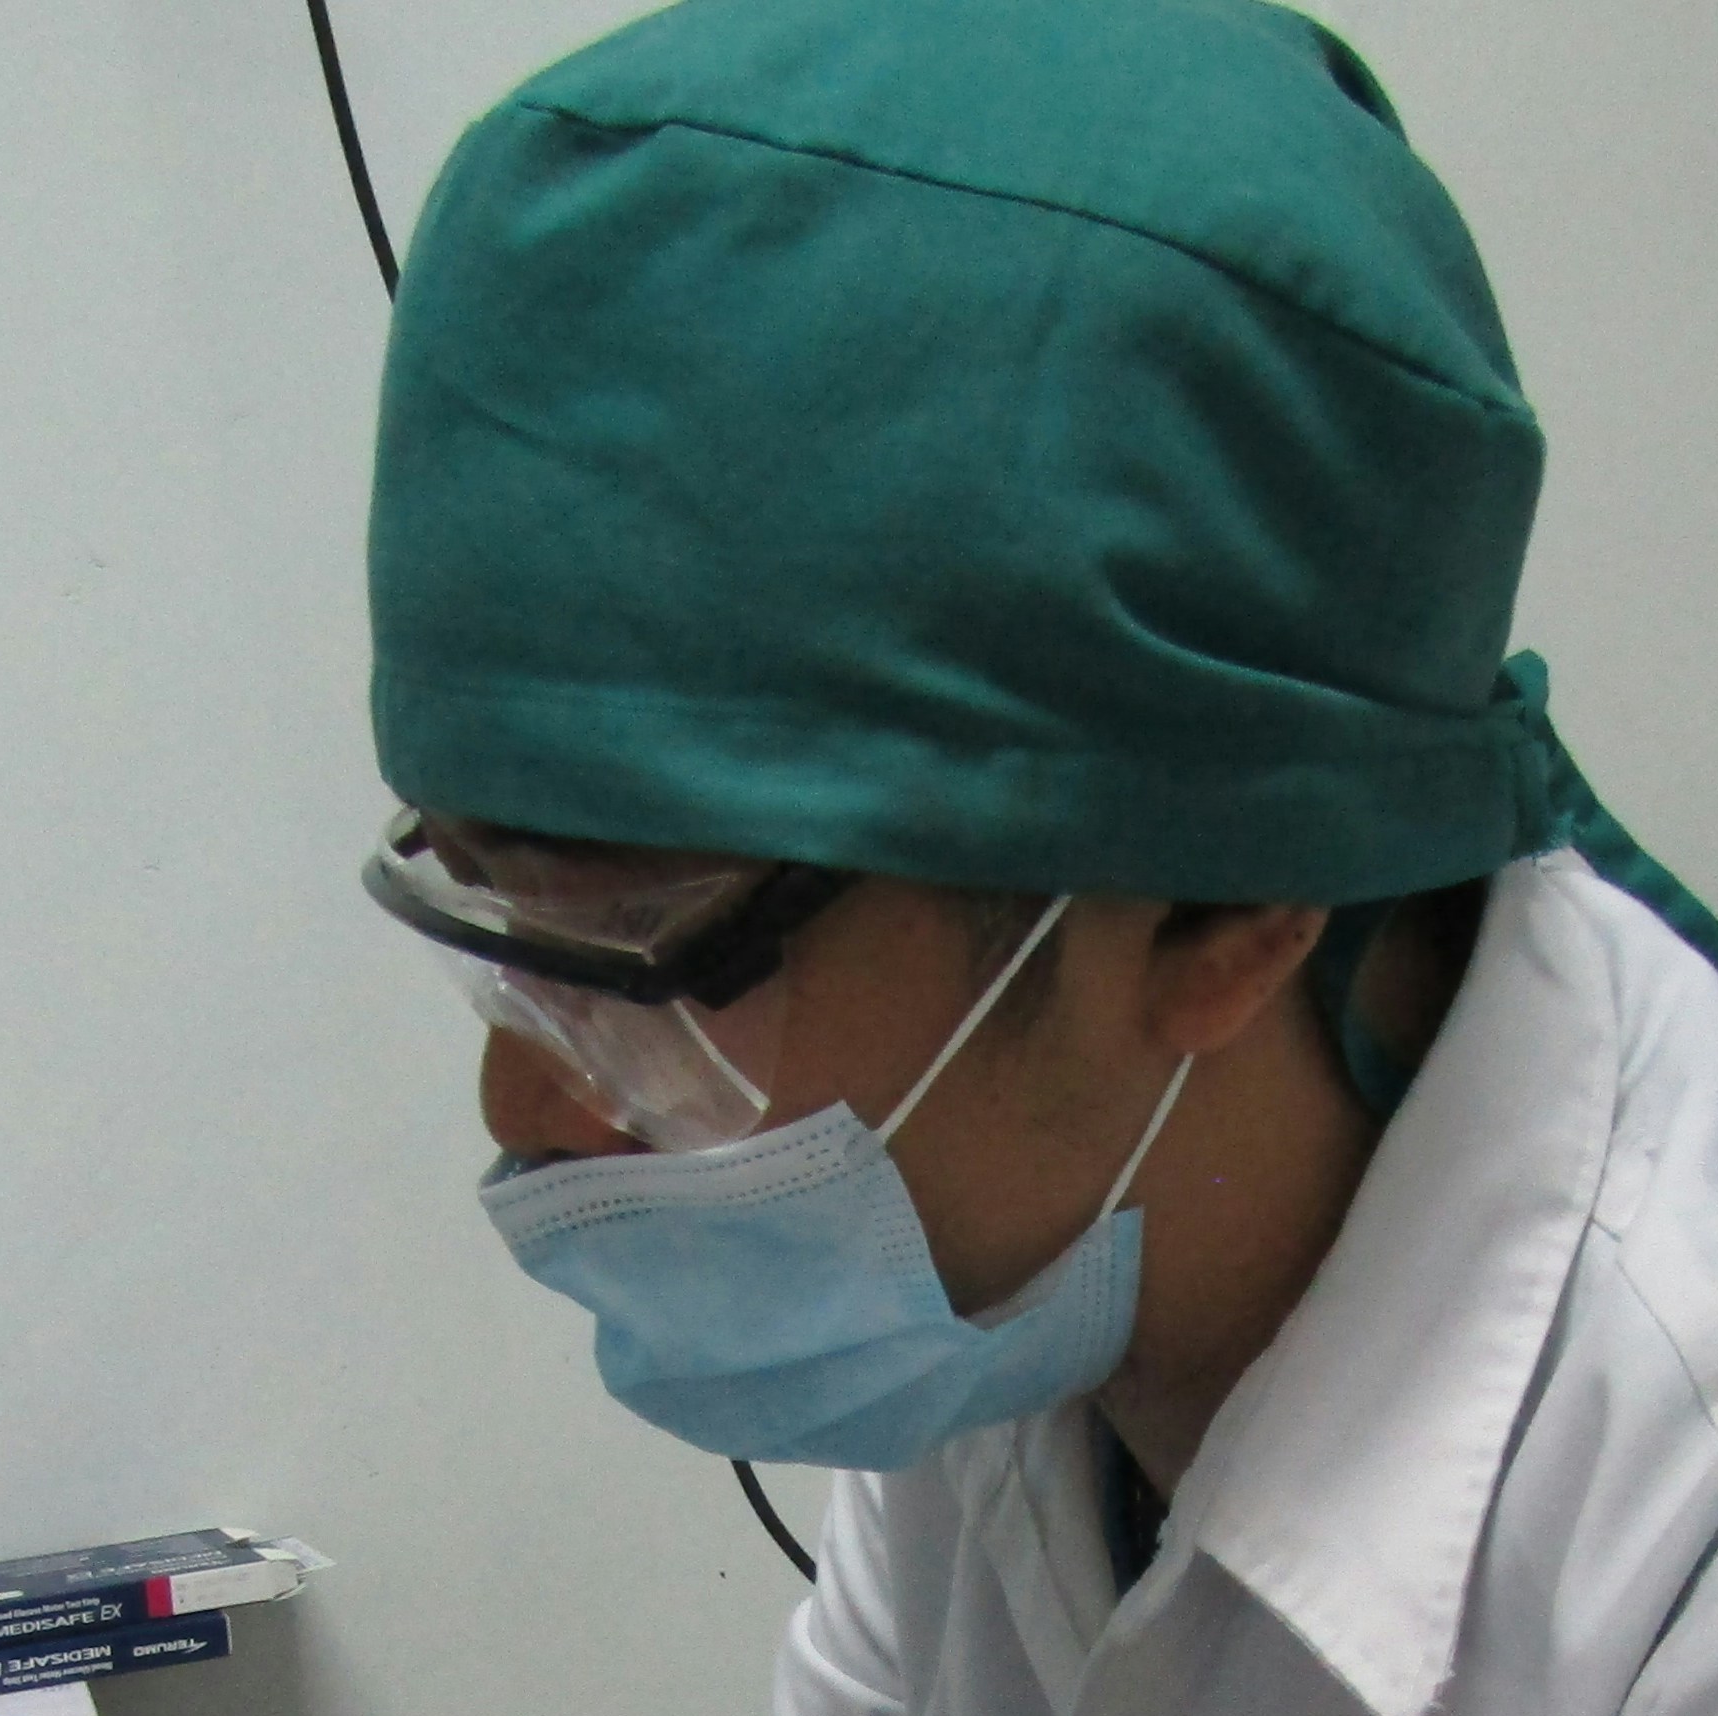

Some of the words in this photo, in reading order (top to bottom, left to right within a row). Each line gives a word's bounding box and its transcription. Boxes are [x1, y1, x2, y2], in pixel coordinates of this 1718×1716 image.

[100, 1602, 123, 1621] EX
[133, 1637, 197, 1657] TERUMO
[8, 1644, 112, 1672] MEDISAFE
